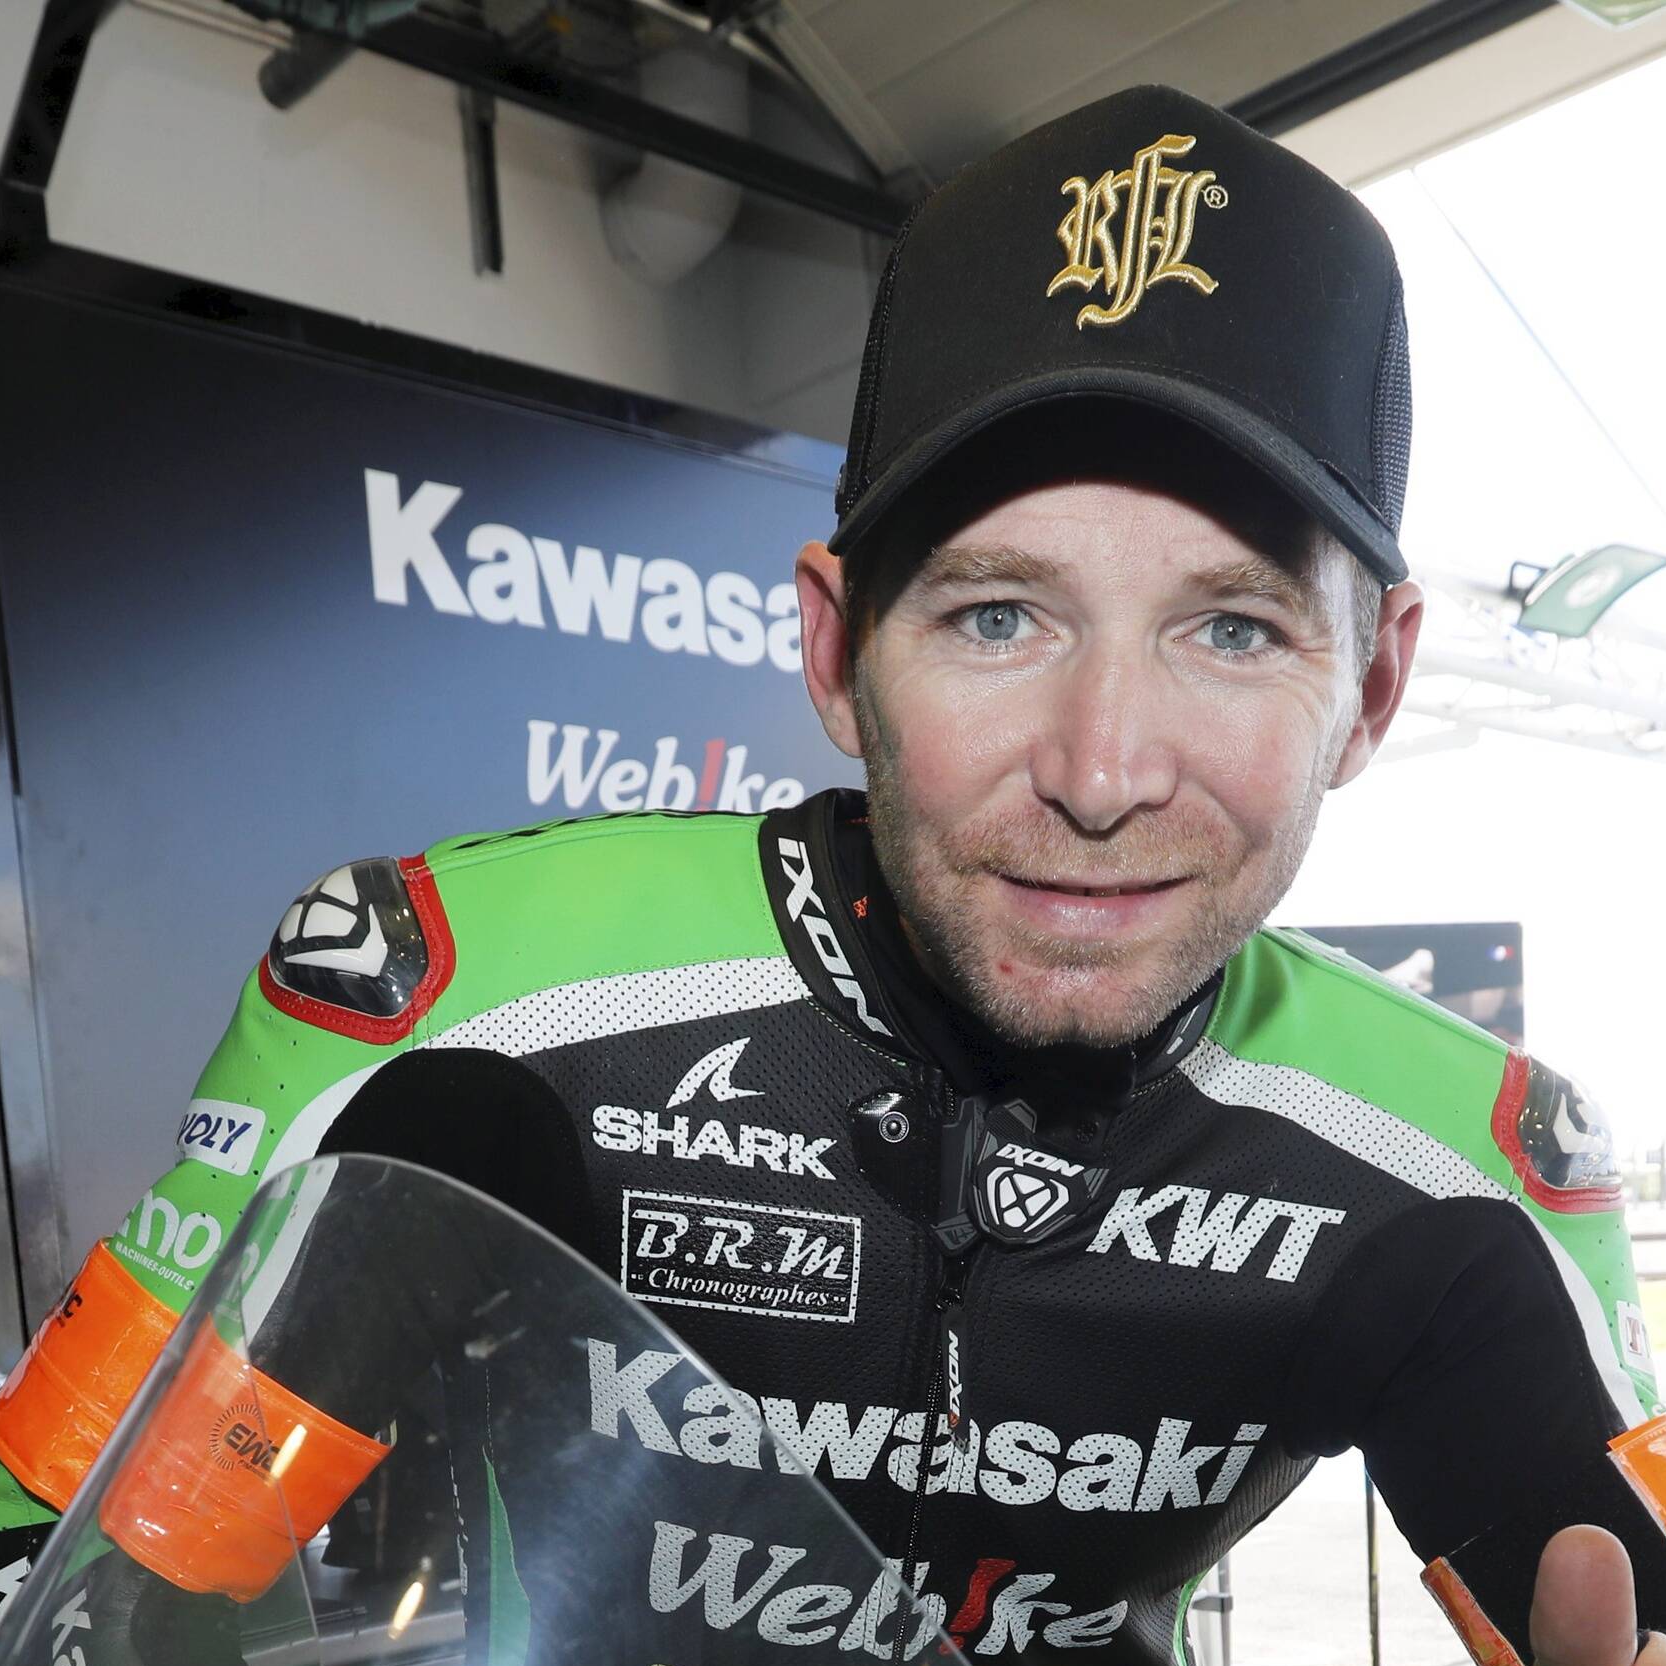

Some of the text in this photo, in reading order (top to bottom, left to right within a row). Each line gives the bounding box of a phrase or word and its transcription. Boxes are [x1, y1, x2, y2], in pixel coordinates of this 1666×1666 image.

[364, 468, 804, 673] Kawasa
[592, 1104, 838, 1181] SHARK
[995, 1143, 1085, 1177] IXON
[1085, 1184, 1347, 1284] KWT
[648, 1267, 830, 1308] Chronographes
[587, 1337, 1267, 1512] Kawasaki
